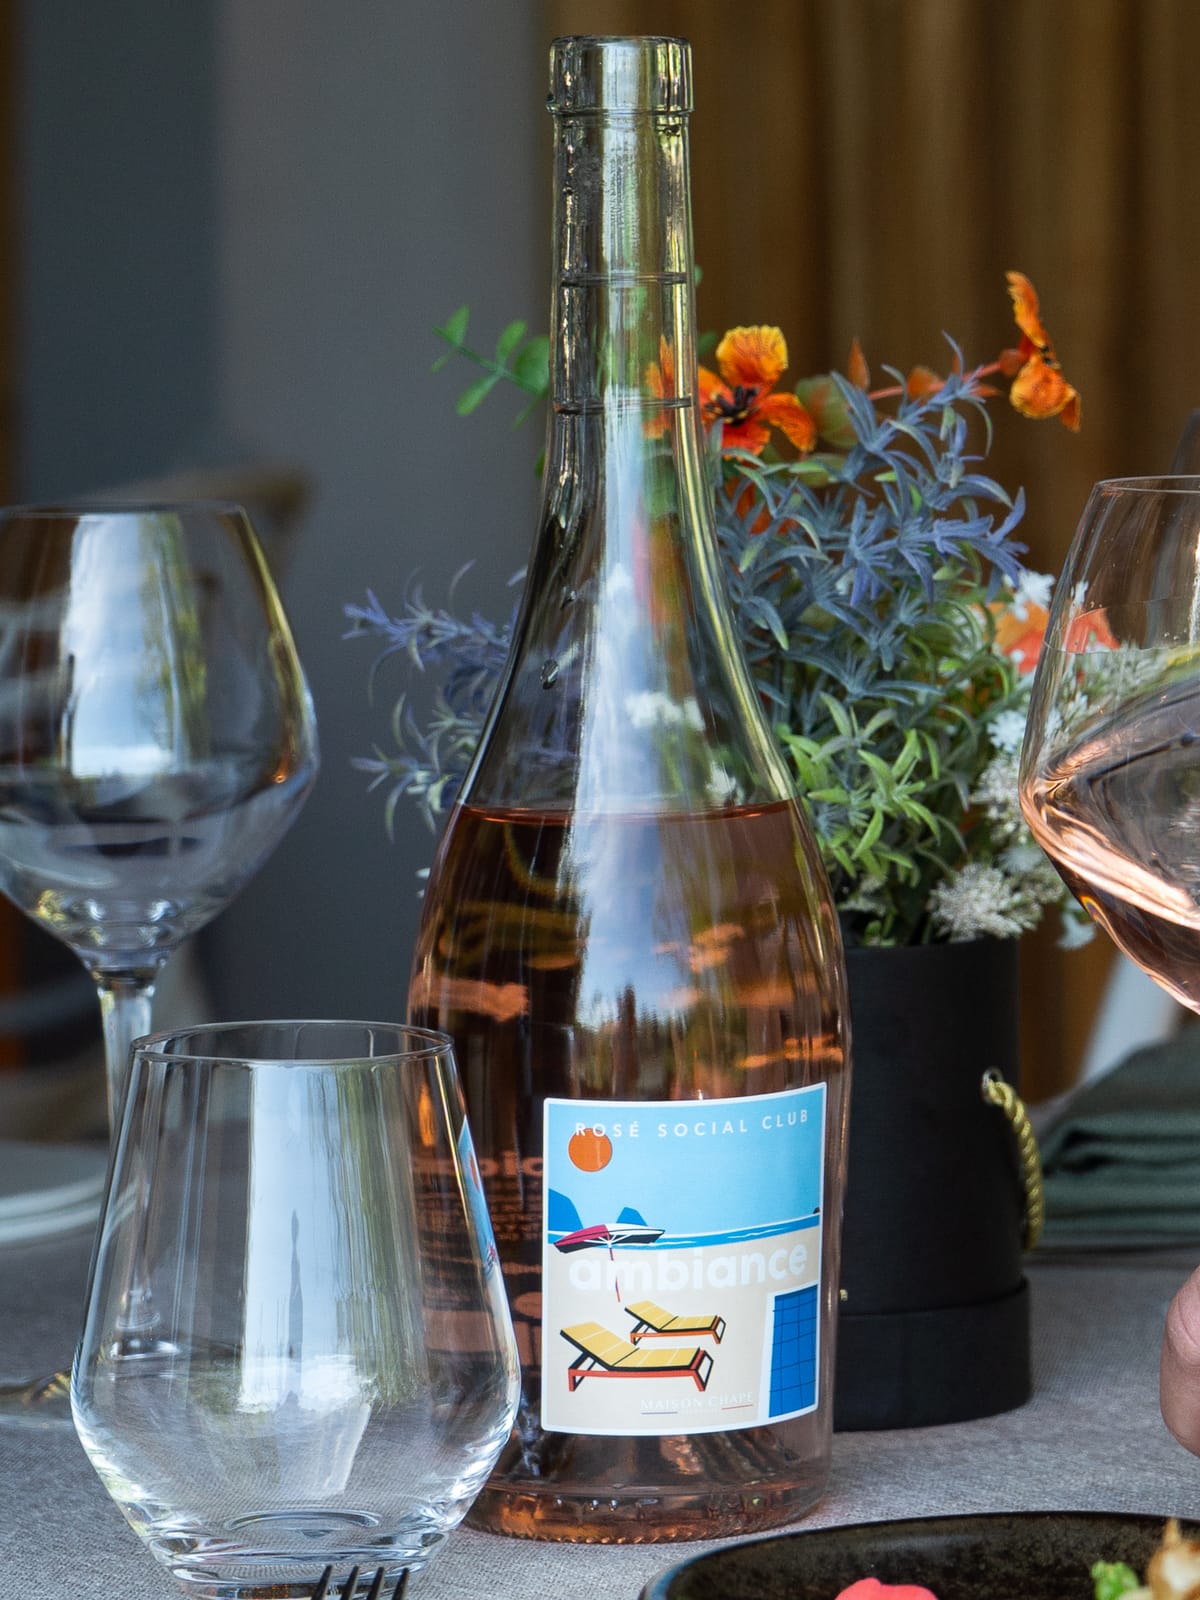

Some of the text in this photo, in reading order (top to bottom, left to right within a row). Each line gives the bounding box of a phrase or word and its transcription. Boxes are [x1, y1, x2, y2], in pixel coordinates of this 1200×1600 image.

[575, 1109, 808, 1138] ROSÉ SOCIAL CLUB
[568, 1242, 809, 1292] ambiance
[640, 1397, 702, 1409] MAISON
